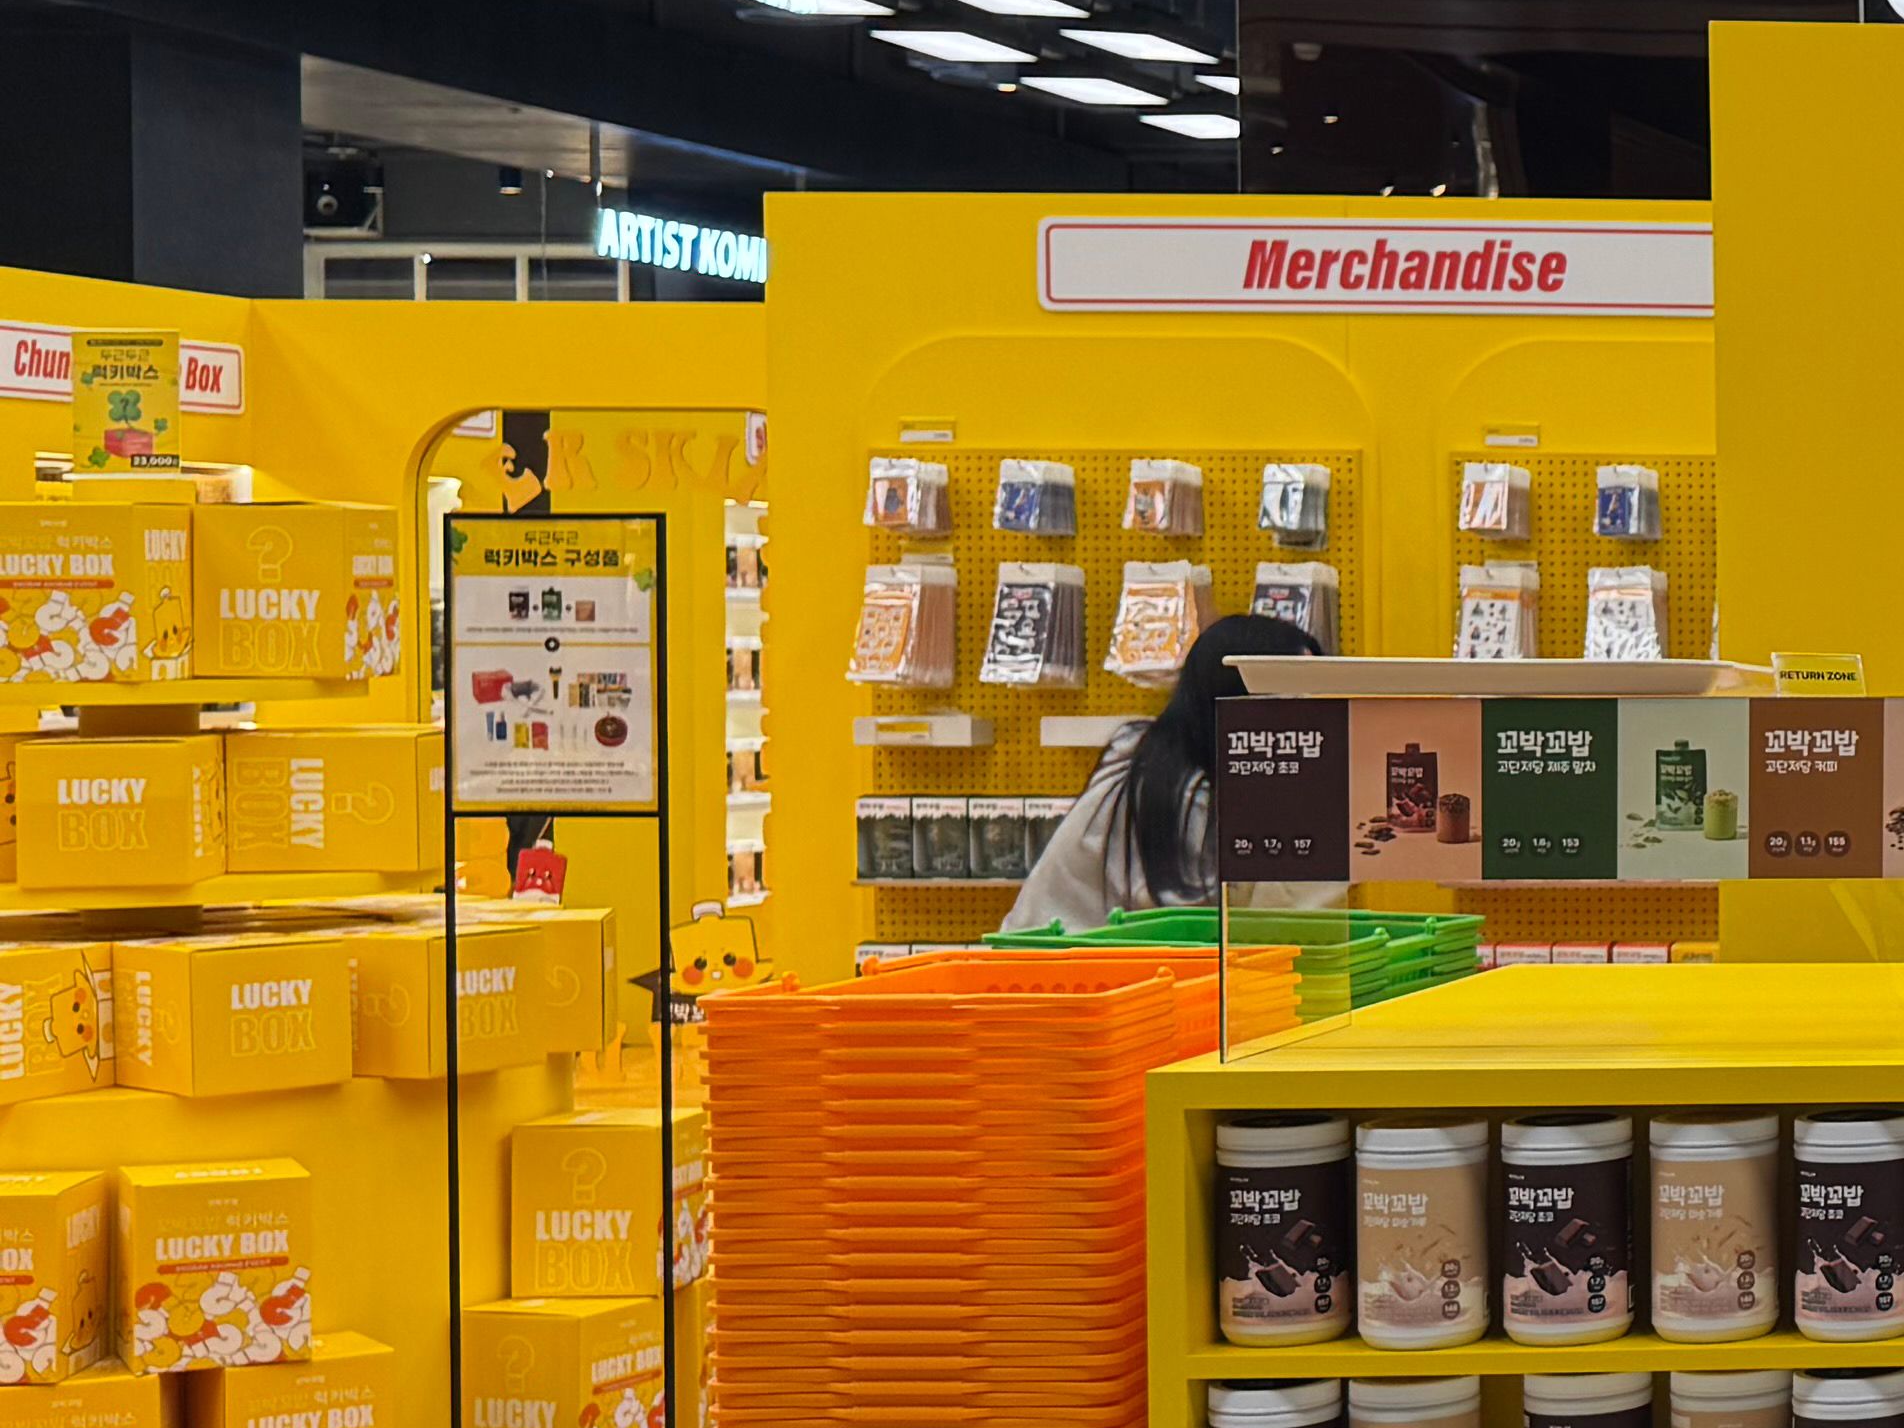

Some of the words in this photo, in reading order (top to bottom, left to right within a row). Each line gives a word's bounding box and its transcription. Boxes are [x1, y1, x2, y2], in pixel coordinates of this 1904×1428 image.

[597, 208, 699, 271] ARTIST
[1243, 238, 1568, 294] Merchandise
[14, 339, 71, 380] Chun
[92, 363, 159, 381] 럭키박스
[524, 531, 579, 545] 두근두근
[70, 554, 114, 576] BOX
[484, 548, 558, 567] 럭키박스
[564, 548, 620, 567] 구성품
[220, 588, 320, 620] LUCKY
[220, 621, 322, 671] BOX
[1780, 670, 1825, 681] RETURN
[1827, 671, 1857, 682] ZONE
[1228, 730, 1325, 759] 꼬박꼬밥
[1497, 730, 1593, 758] 꼬박꼬밥
[1764, 729, 1859, 757] 꼬박꼬밥
[1278, 761, 1300, 775] 초코
[1547, 760, 1571, 774] 제주
[1572, 760, 1597, 774] 말차
[1814, 759, 1838, 773] 커피
[58, 778, 146, 805] LUCKY
[290, 758, 325, 850] LUCKY
[58, 810, 149, 852] BOX
[1294, 839, 1312, 849] 157
[1562, 838, 1580, 847] 153
[230, 979, 313, 1011] LUCKY
[456, 966, 517, 997] LUCKY
[0, 982, 24, 1081] LUCKY
[136, 972, 153, 1067] LUCKY
[230, 1008, 317, 1058] BOX
[1230, 1190, 1301, 1212] 꼬박꼬밥
[1800, 1184, 1864, 1206] 꼬박꼬밥
[535, 1210, 633, 1241] LUCKY
[156, 1234, 234, 1261] LUCKY
[240, 1229, 289, 1255] BOX
[1, 1249, 34, 1271] OX
[535, 1240, 634, 1292] BOX
